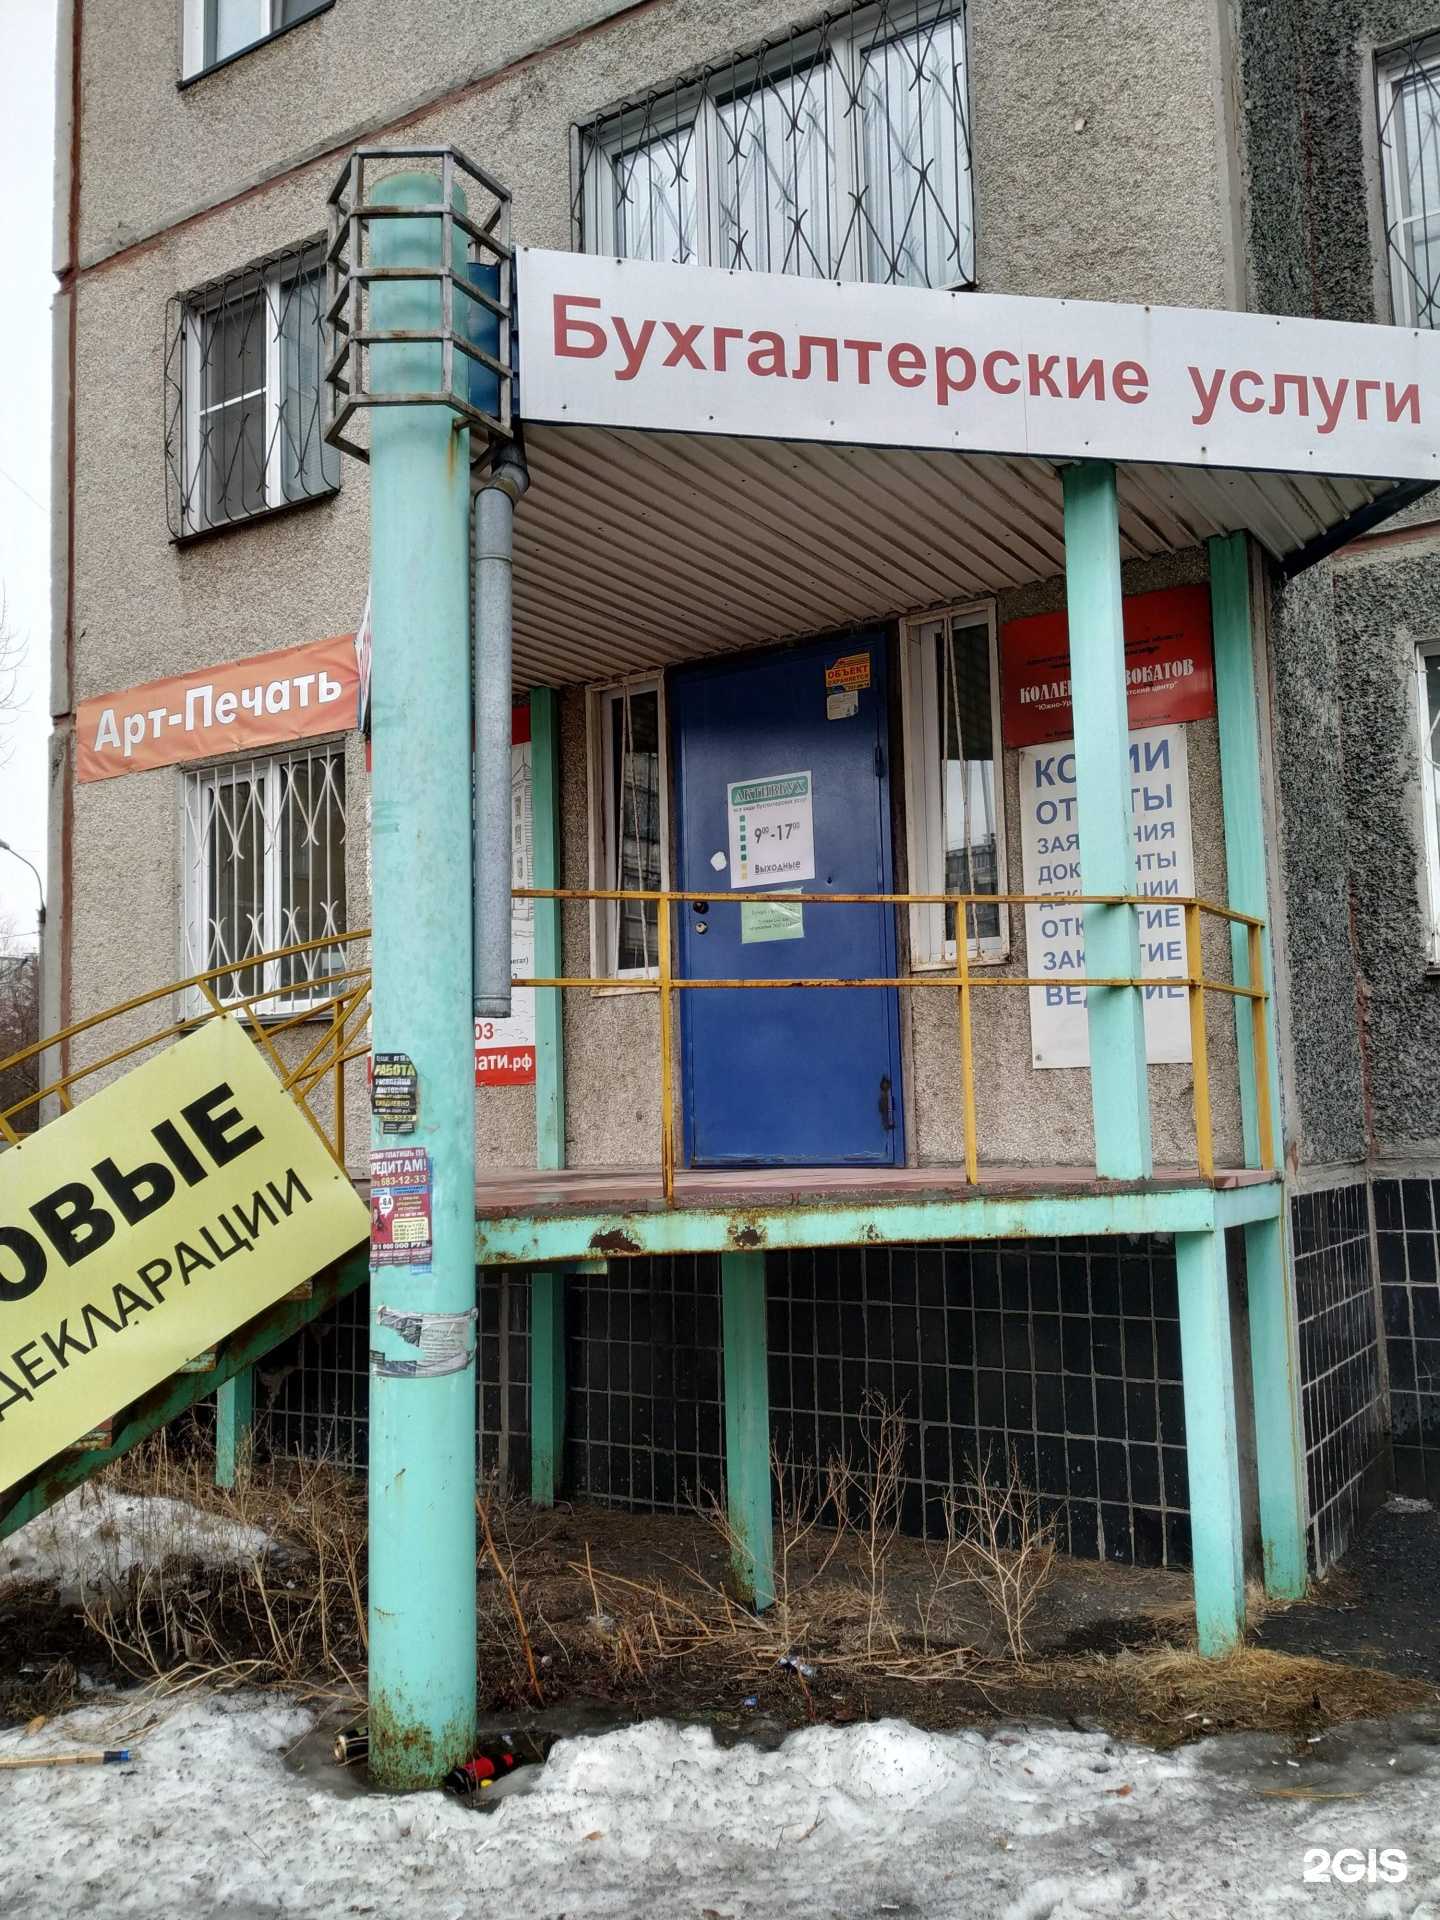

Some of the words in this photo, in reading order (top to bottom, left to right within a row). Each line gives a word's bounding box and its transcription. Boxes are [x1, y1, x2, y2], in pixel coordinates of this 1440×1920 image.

[555, 297, 1149, 404] Бухгалтерские
[1189, 366, 1421, 434] услуги
[827, 664, 868, 680] ОБЪЕКТ
[94, 670, 343, 757] Арт-Печать
[754, 861, 801, 874] Выходные
[374, 1063, 416, 1077] РАБОТА
